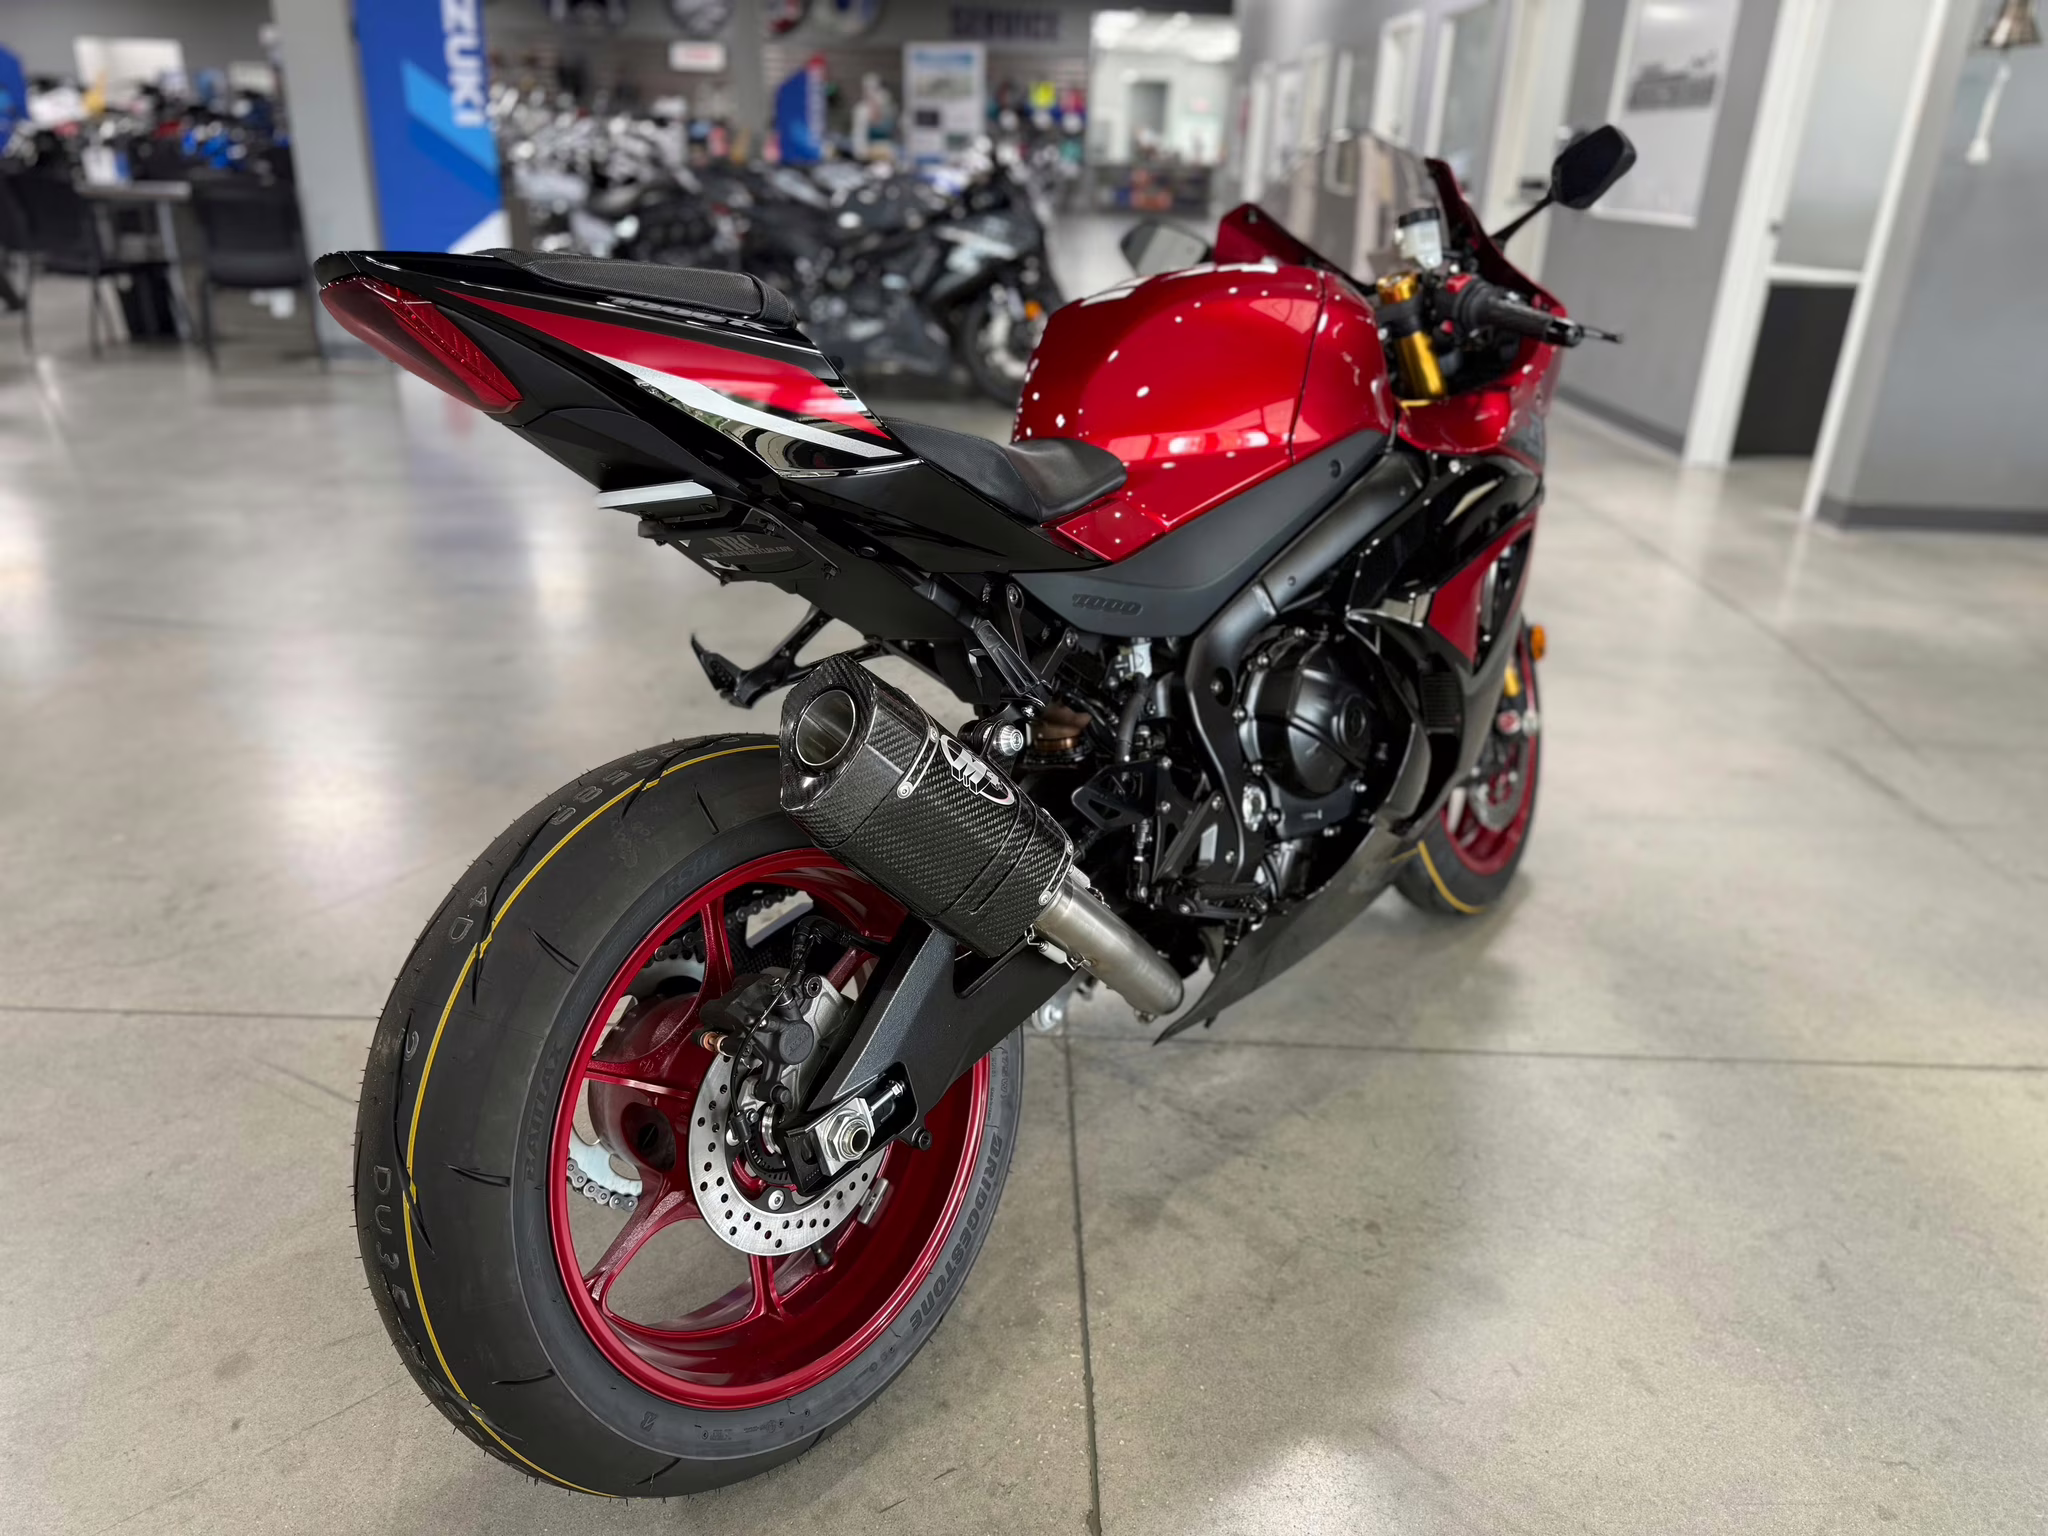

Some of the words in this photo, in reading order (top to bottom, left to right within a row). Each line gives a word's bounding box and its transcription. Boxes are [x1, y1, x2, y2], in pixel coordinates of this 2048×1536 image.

[707, 534, 760, 552] NRC
[1072, 593, 1144, 616] 1000
[909, 1131, 1003, 1332] BRIDGESTONE
